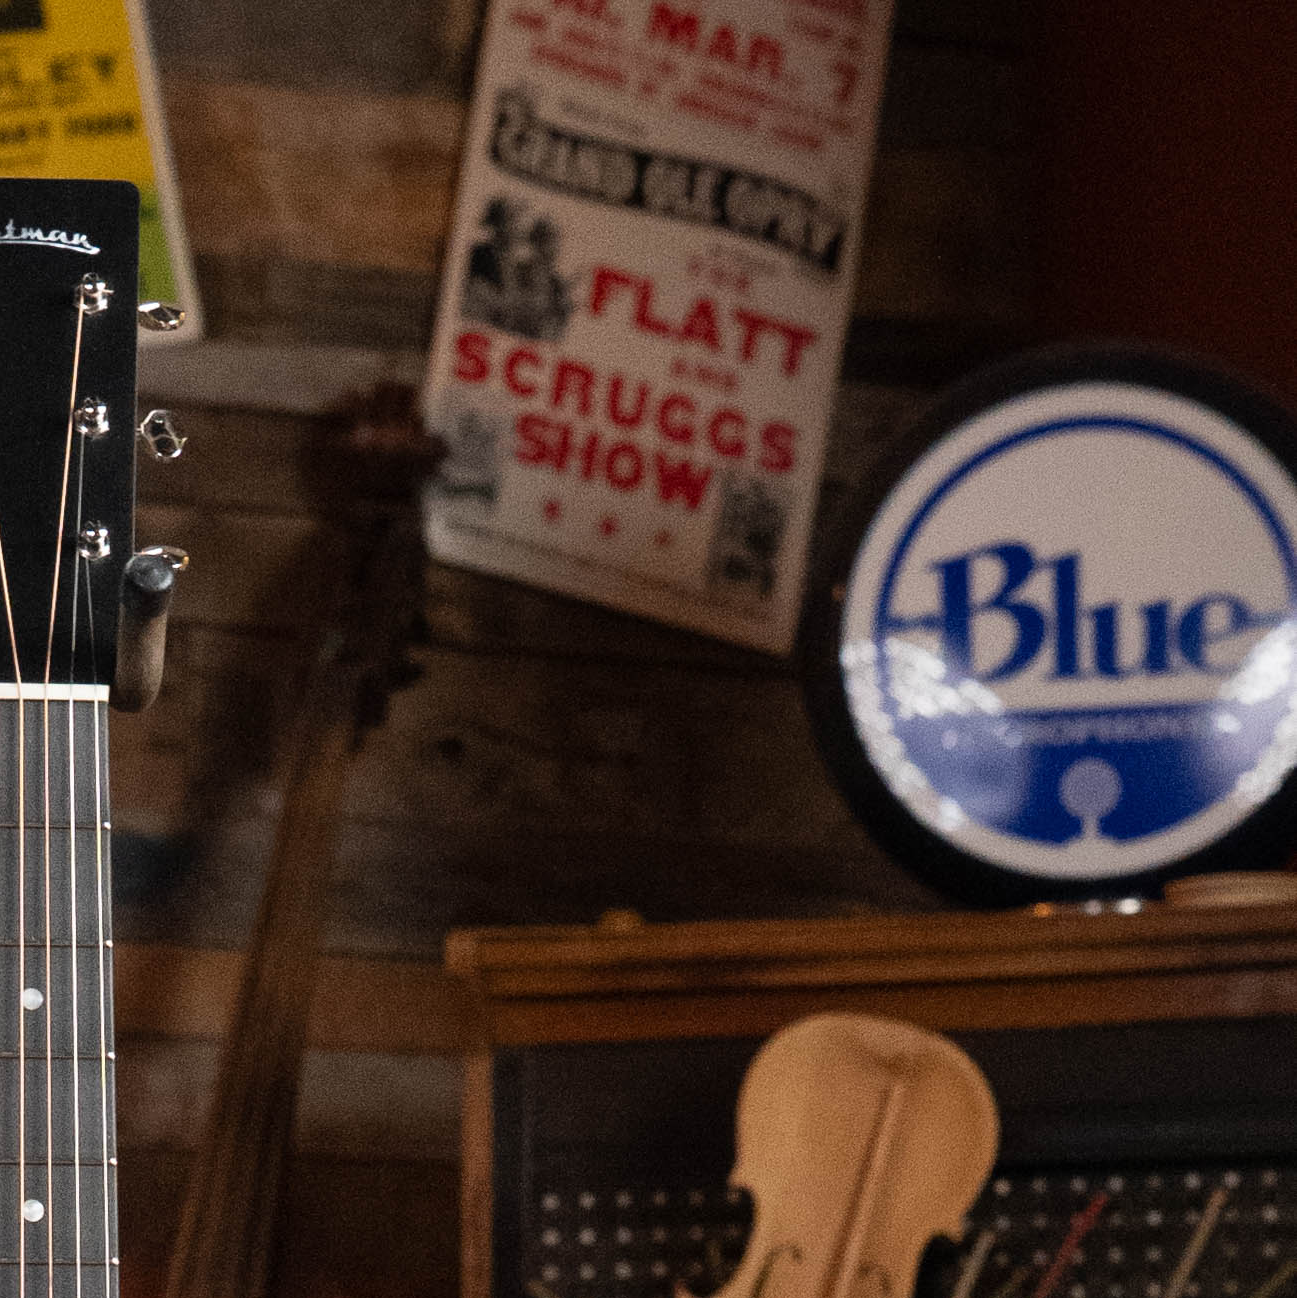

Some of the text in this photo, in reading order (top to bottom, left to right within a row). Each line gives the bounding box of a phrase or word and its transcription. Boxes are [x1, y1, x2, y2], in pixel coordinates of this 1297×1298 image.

[591, 266, 819, 378] FLATT
[452, 332, 798, 473] SCRUGGS
[514, 413, 713, 513] SHOW
[928, 541, 1247, 683] Blue
